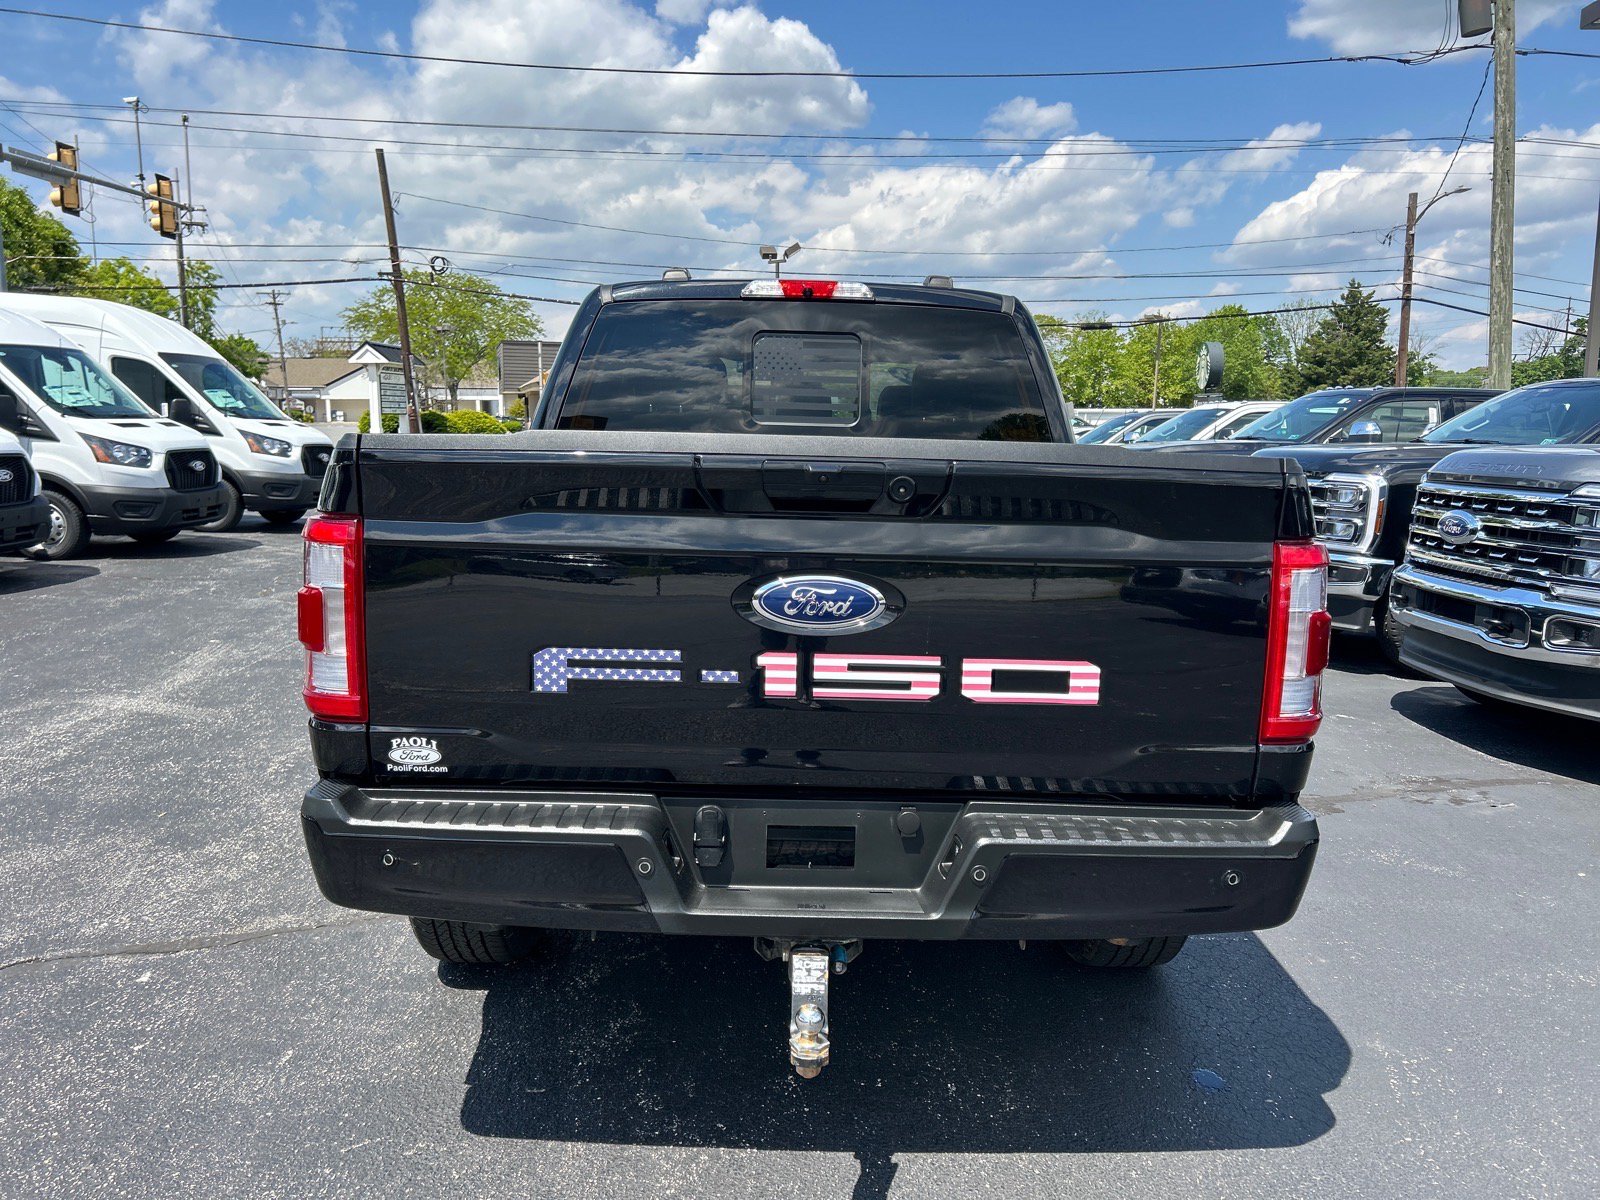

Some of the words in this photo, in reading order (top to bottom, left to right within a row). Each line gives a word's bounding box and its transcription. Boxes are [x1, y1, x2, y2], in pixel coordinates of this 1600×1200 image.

[1443, 518, 1463, 534] Ford
[783, 586, 854, 617] Ford
[531, 646, 1102, 706] F-150
[390, 737, 438, 750] PAOLI
[399, 750, 430, 761] Ford
[386, 764, 448, 773] PaoliFord.com
